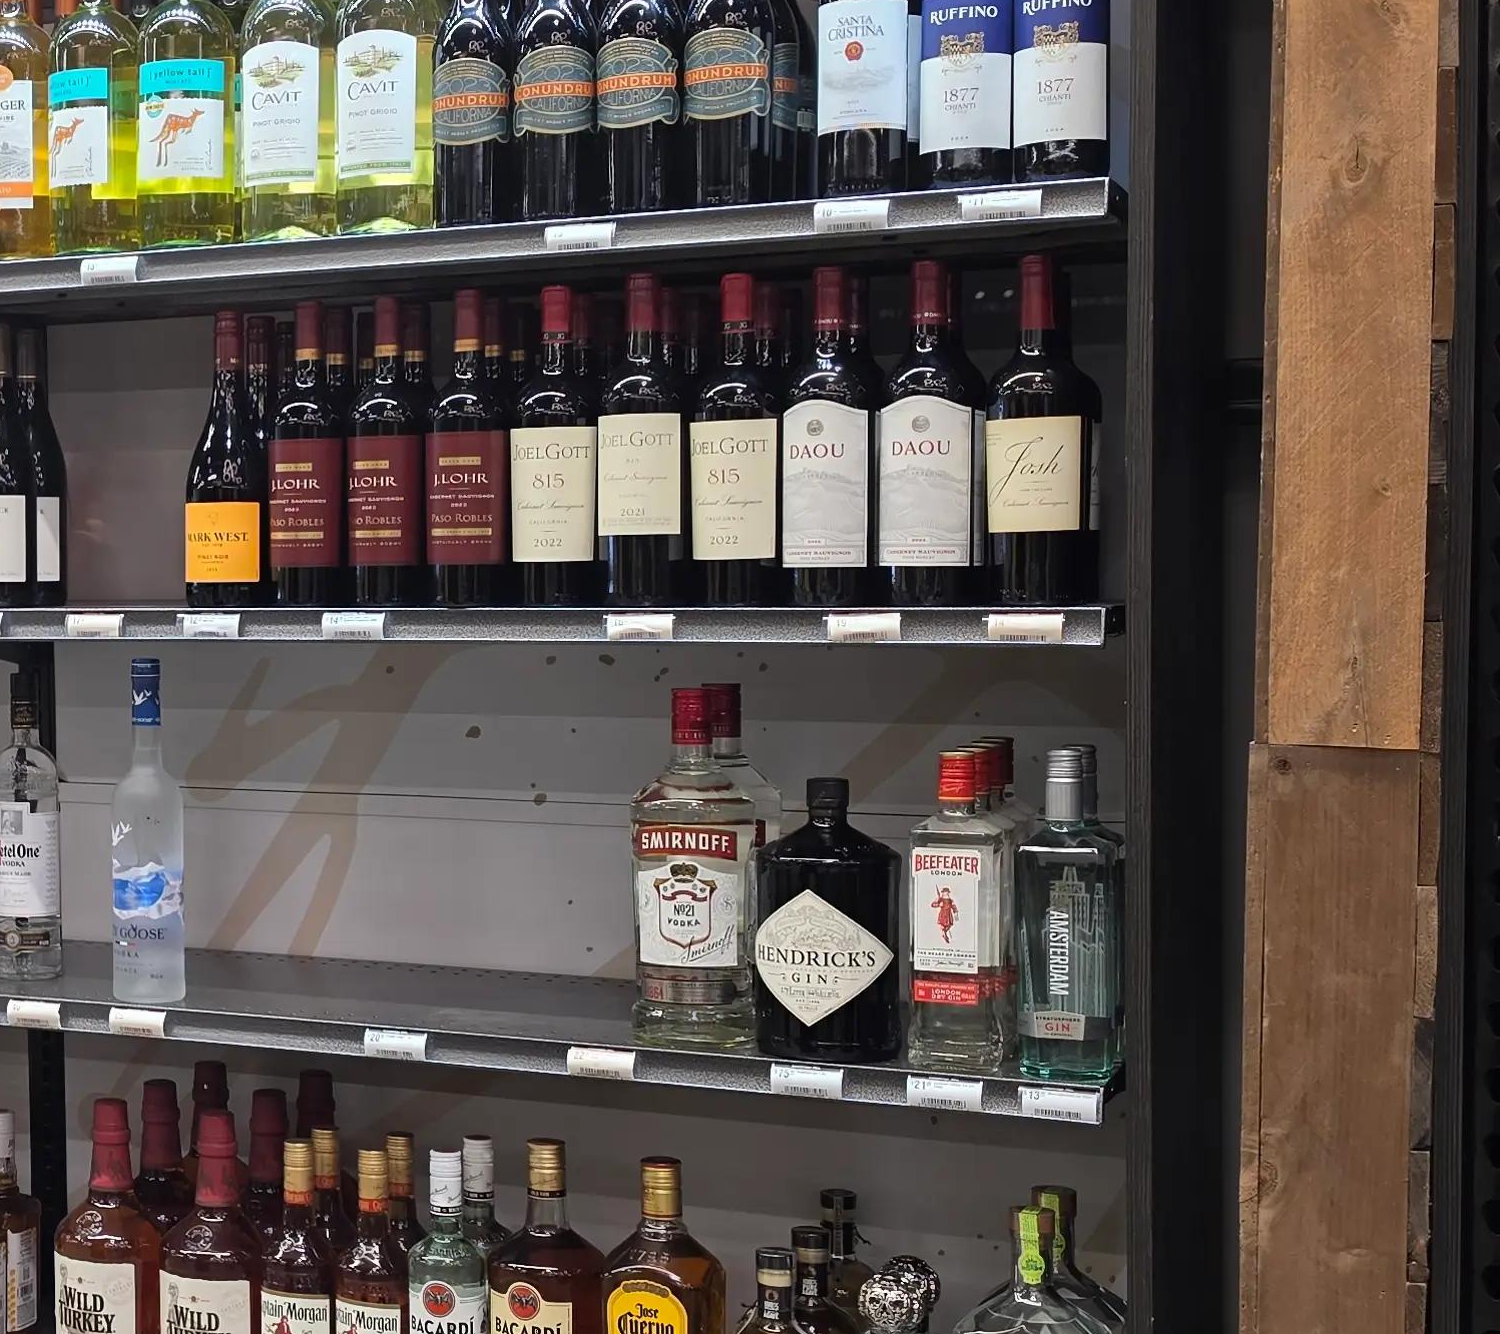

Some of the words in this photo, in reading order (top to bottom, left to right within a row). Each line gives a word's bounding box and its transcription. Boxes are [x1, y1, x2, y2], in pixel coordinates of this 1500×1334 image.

[837, 15, 874, 27] SANTA
[929, 5, 999, 25] RUFFINO
[828, 25, 885, 42] CRISTINA
[347, 80, 399, 101] CAVIT
[1037, 78, 1074, 94] 1877
[252, 90, 301, 110] CAVIT
[943, 88, 980, 104] 1877
[1038, 93, 1071, 103] CHIANTI
[944, 102, 976, 112] CHIANTI
[601, 433, 628, 450] JOEL
[629, 431, 674, 446] GOTT
[720, 437, 769, 455] GOTT
[891, 440, 951, 457] DAOU
[790, 443, 845, 460] DAOU
[707, 468, 740, 484] 815
[989, 436, 1065, 507] Josh
[532, 473, 565, 489] 815
[364, 516, 402, 525] ROBLES
[431, 513, 451, 523] PASO
[453, 513, 493, 523] ROBLES
[620, 507, 646, 517] 2021
[533, 538, 563, 547] 2022
[710, 535, 739, 545] 2022
[641, 831, 730, 852] SMIRNOFF
[915, 854, 979, 875] BEEFEATER
[119, 925, 165, 939] GOOSE
[681, 925, 734, 963] Smirnoff
[758, 944, 876, 967] HENDRICK'S
[1049, 910, 1070, 996] AMSTERDAM
[791, 972, 828, 984] GIN
[63, 1285, 105, 1314] WILD
[58, 1299, 116, 1334] TURKEY
[173, 1303, 220, 1331] WILD
[287, 1301, 328, 1323] Morgan
[634, 1302, 660, 1319] Jose
[354, 1310, 398, 1333] Morgan
